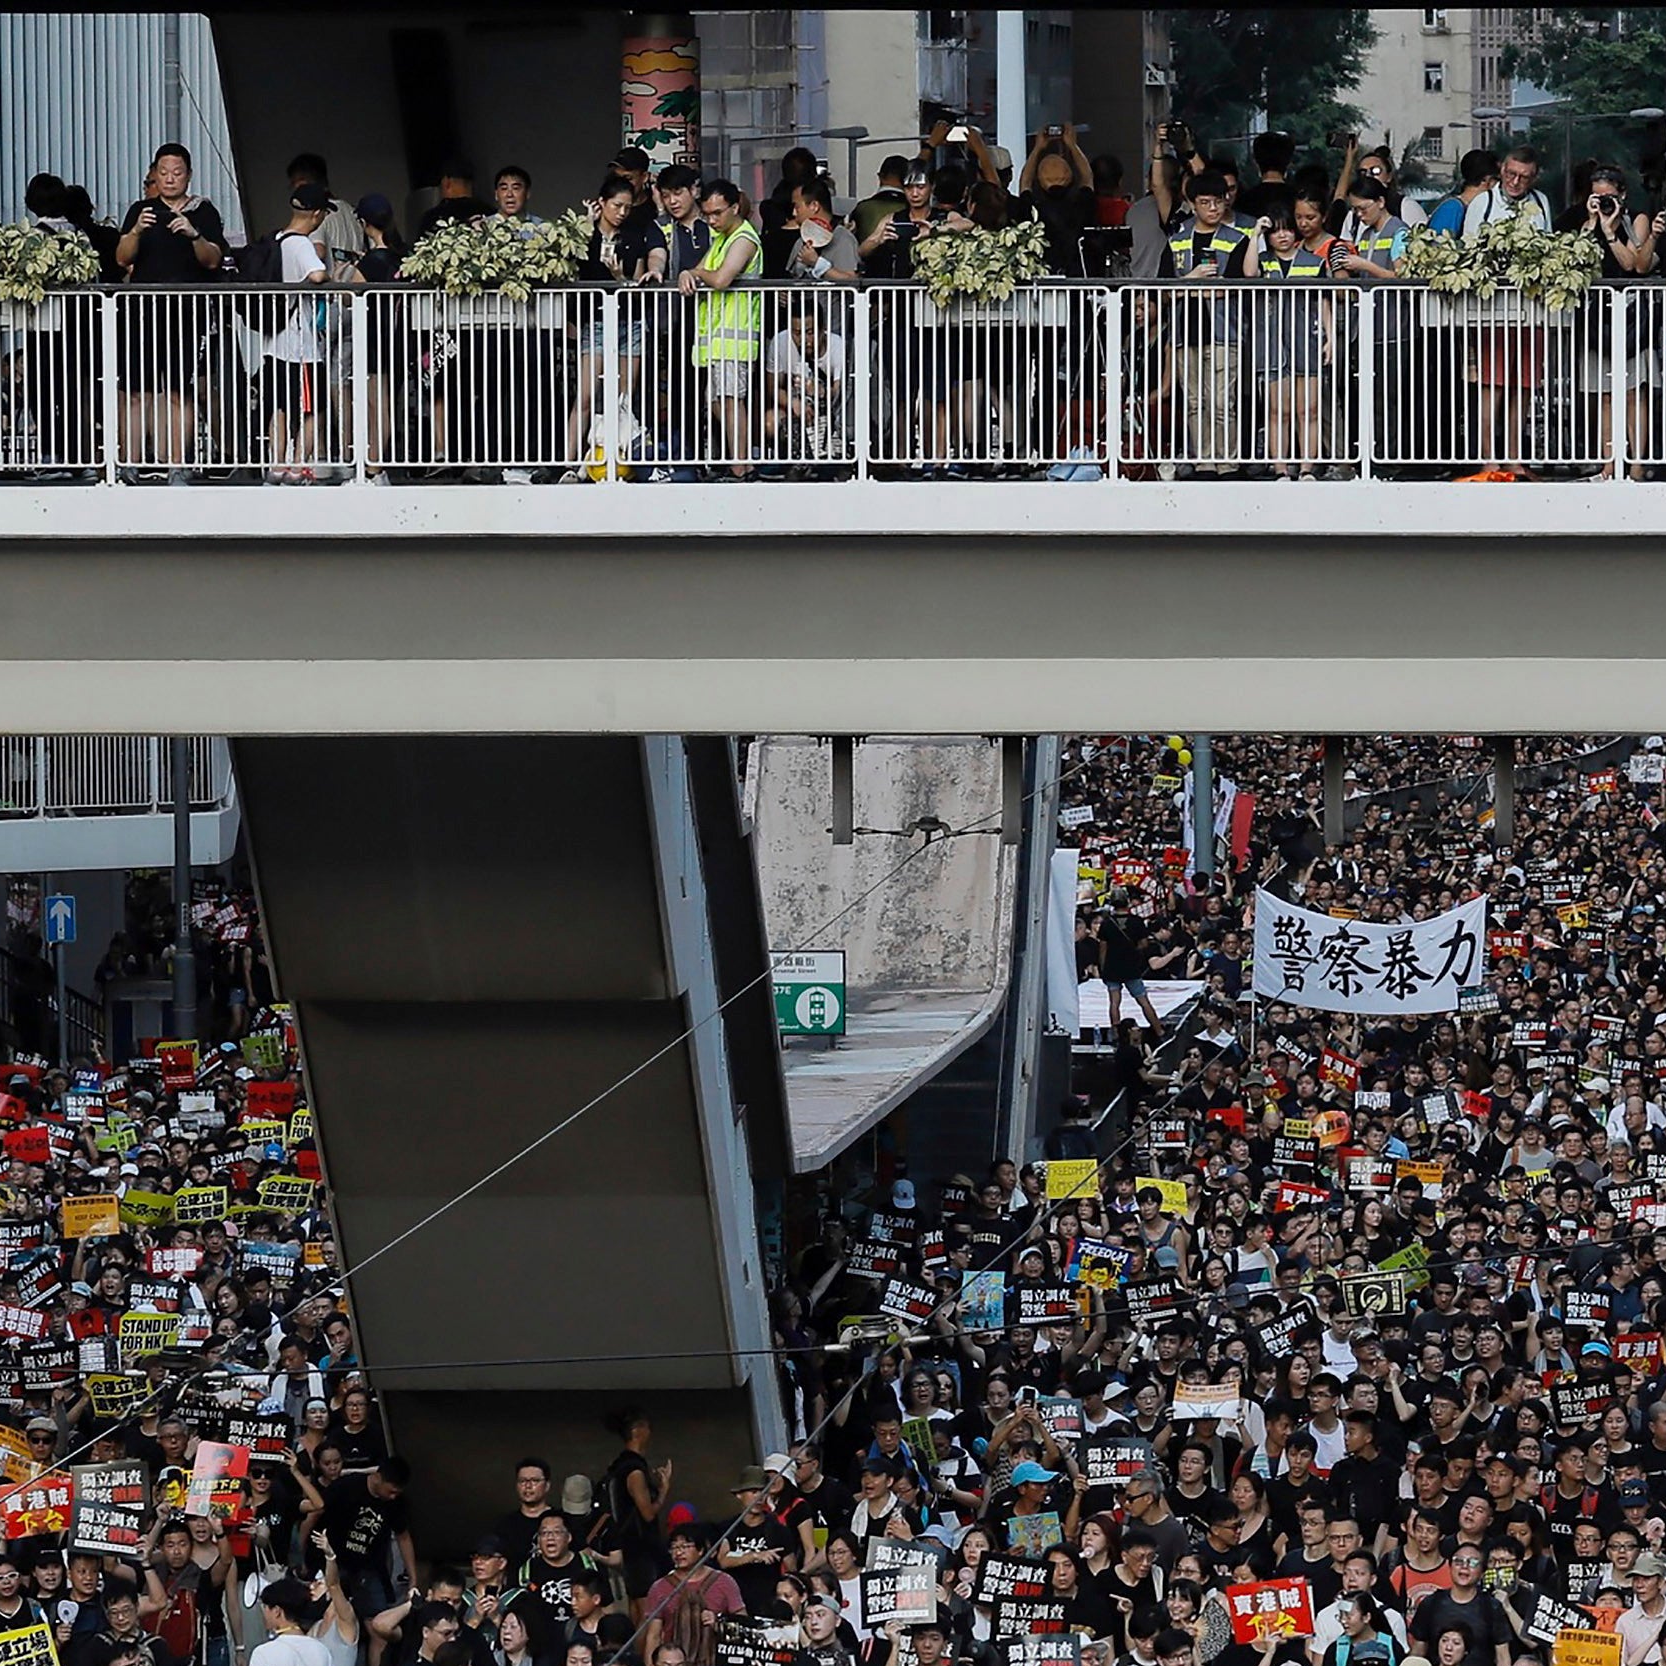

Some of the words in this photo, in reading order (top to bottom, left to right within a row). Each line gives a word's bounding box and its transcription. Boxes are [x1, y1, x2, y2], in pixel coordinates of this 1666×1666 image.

[1272, 917, 1476, 998] 警察暴力
[1079, 1241, 1131, 1265] FREEDOM
[122, 1318, 162, 1334] STAND
[164, 1316, 179, 1331] UP
[122, 1333, 145, 1350] FOR
[6, 1488, 68, 1512] 賣港賊
[1234, 1589, 1301, 1615] 賣港賊
[1008, 1642, 1072, 1662] 獨立調查
